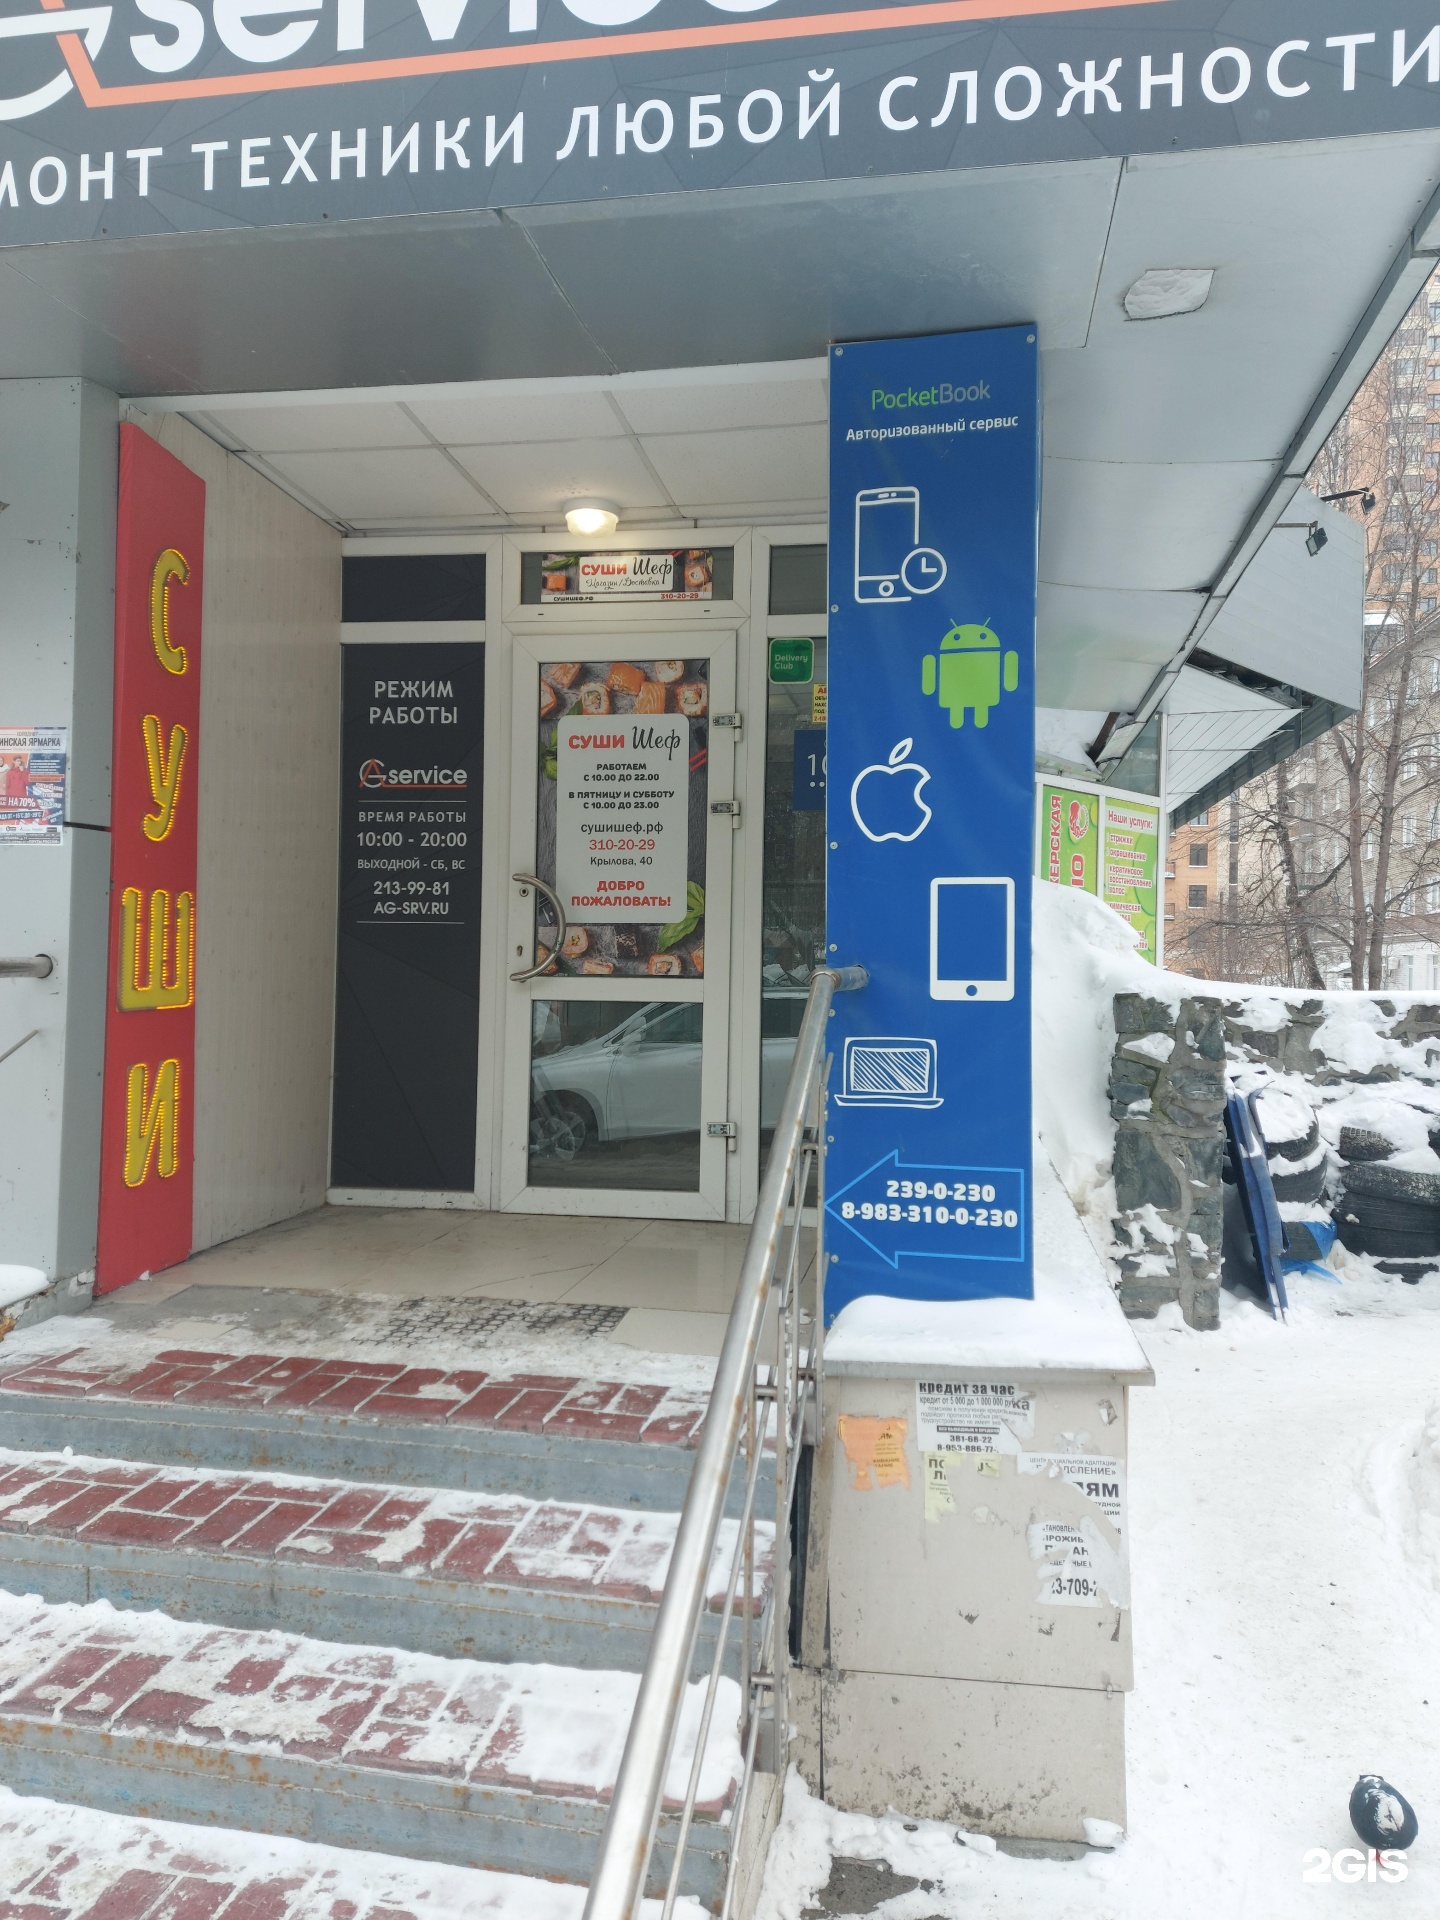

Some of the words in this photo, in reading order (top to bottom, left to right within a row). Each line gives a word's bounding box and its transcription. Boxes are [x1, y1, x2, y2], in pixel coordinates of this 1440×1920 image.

[191, 112, 524, 191] ТЕХНИКИ
[556, 67, 840, 158] ЛЮБОЙ
[879, 25, 1440, 131] СЛОЖНОСТИ
[872, 380, 991, 410] PocketBook
[846, 418, 966, 441] Авторизованный
[970, 416, 1019, 432] сервис
[581, 564, 627, 576] СУШИ
[632, 556, 673, 584] Шеф
[661, 592, 699, 600] 310-20-29
[774, 653, 808, 663] Delivery
[774, 662, 794, 670] Club
[374, 681, 454, 699] РЕЖИМ
[369, 706, 458, 725] РАБОТЫ
[28, 738, 61, 747] ЯРМАРКА
[568, 734, 625, 749] СУШИ
[632, 725, 682, 760] Шеф
[597, 763, 647, 771] РАБОТАЕМ
[583, 774, 590, 782] С
[591, 773, 616, 782] 10.00
[618, 773, 632, 783] ДО
[634, 773, 660, 781] 22.00
[568, 791, 575, 799] В
[577, 791, 622, 799] ПЯТНИЦУ
[624, 791, 630, 799] И
[633, 790, 675, 798] СУББОТУ
[591, 801, 616, 810] 10.00
[618, 801, 632, 810] ДО
[634, 801, 660, 809] 23.00
[358, 811, 404, 823] ВРЕМЯ
[409, 811, 467, 823] РАБОТЫ
[1108, 810, 1128, 824] Наши
[1129, 817, 1153, 830] услуги:
[580, 821, 664, 834] сушишеф.рф
[357, 832, 403, 847] 10:00
[420, 832, 467, 847] 20:00
[589, 839, 656, 851] 310-20-29
[1110, 834, 1133, 845] стрижки
[1109, 848, 1146, 861] окрашивание
[357, 857, 420, 871] ВЫХОДНОЙ
[430, 859, 448, 871] СБ,
[452, 859, 466, 870] ВС
[590, 856, 637, 867] Крылова,
[639, 856, 653, 866] 40
[1109, 865, 1144, 876] кератиновое
[596, 880, 645, 892] ДОБРО
[1109, 875, 1152, 888] восстановление
[373, 881, 450, 896] 213-99-81
[1109, 887, 1125, 895] волос
[571, 896, 671, 907] ПОЖАЛОВАТЬ!
[373, 901, 450, 915] AG-SRV.RU
[886, 1180, 996, 1203] 239-0-230
[841, 1202, 1019, 1228] 8-983-310-0-230
[919, 1382, 969, 1395] кредит
[972, 1384, 988, 1395] за
[990, 1384, 1015, 1396] час
[920, 1397, 941, 1406] кредит
[967, 1398, 975, 1406] до
[981, 1397, 992, 1405] 000
[993, 1398, 1003, 1406] 000
[950, 1435, 993, 1443] 381-68-22
[937, 1444, 999, 1453] 8-953-886-77-
